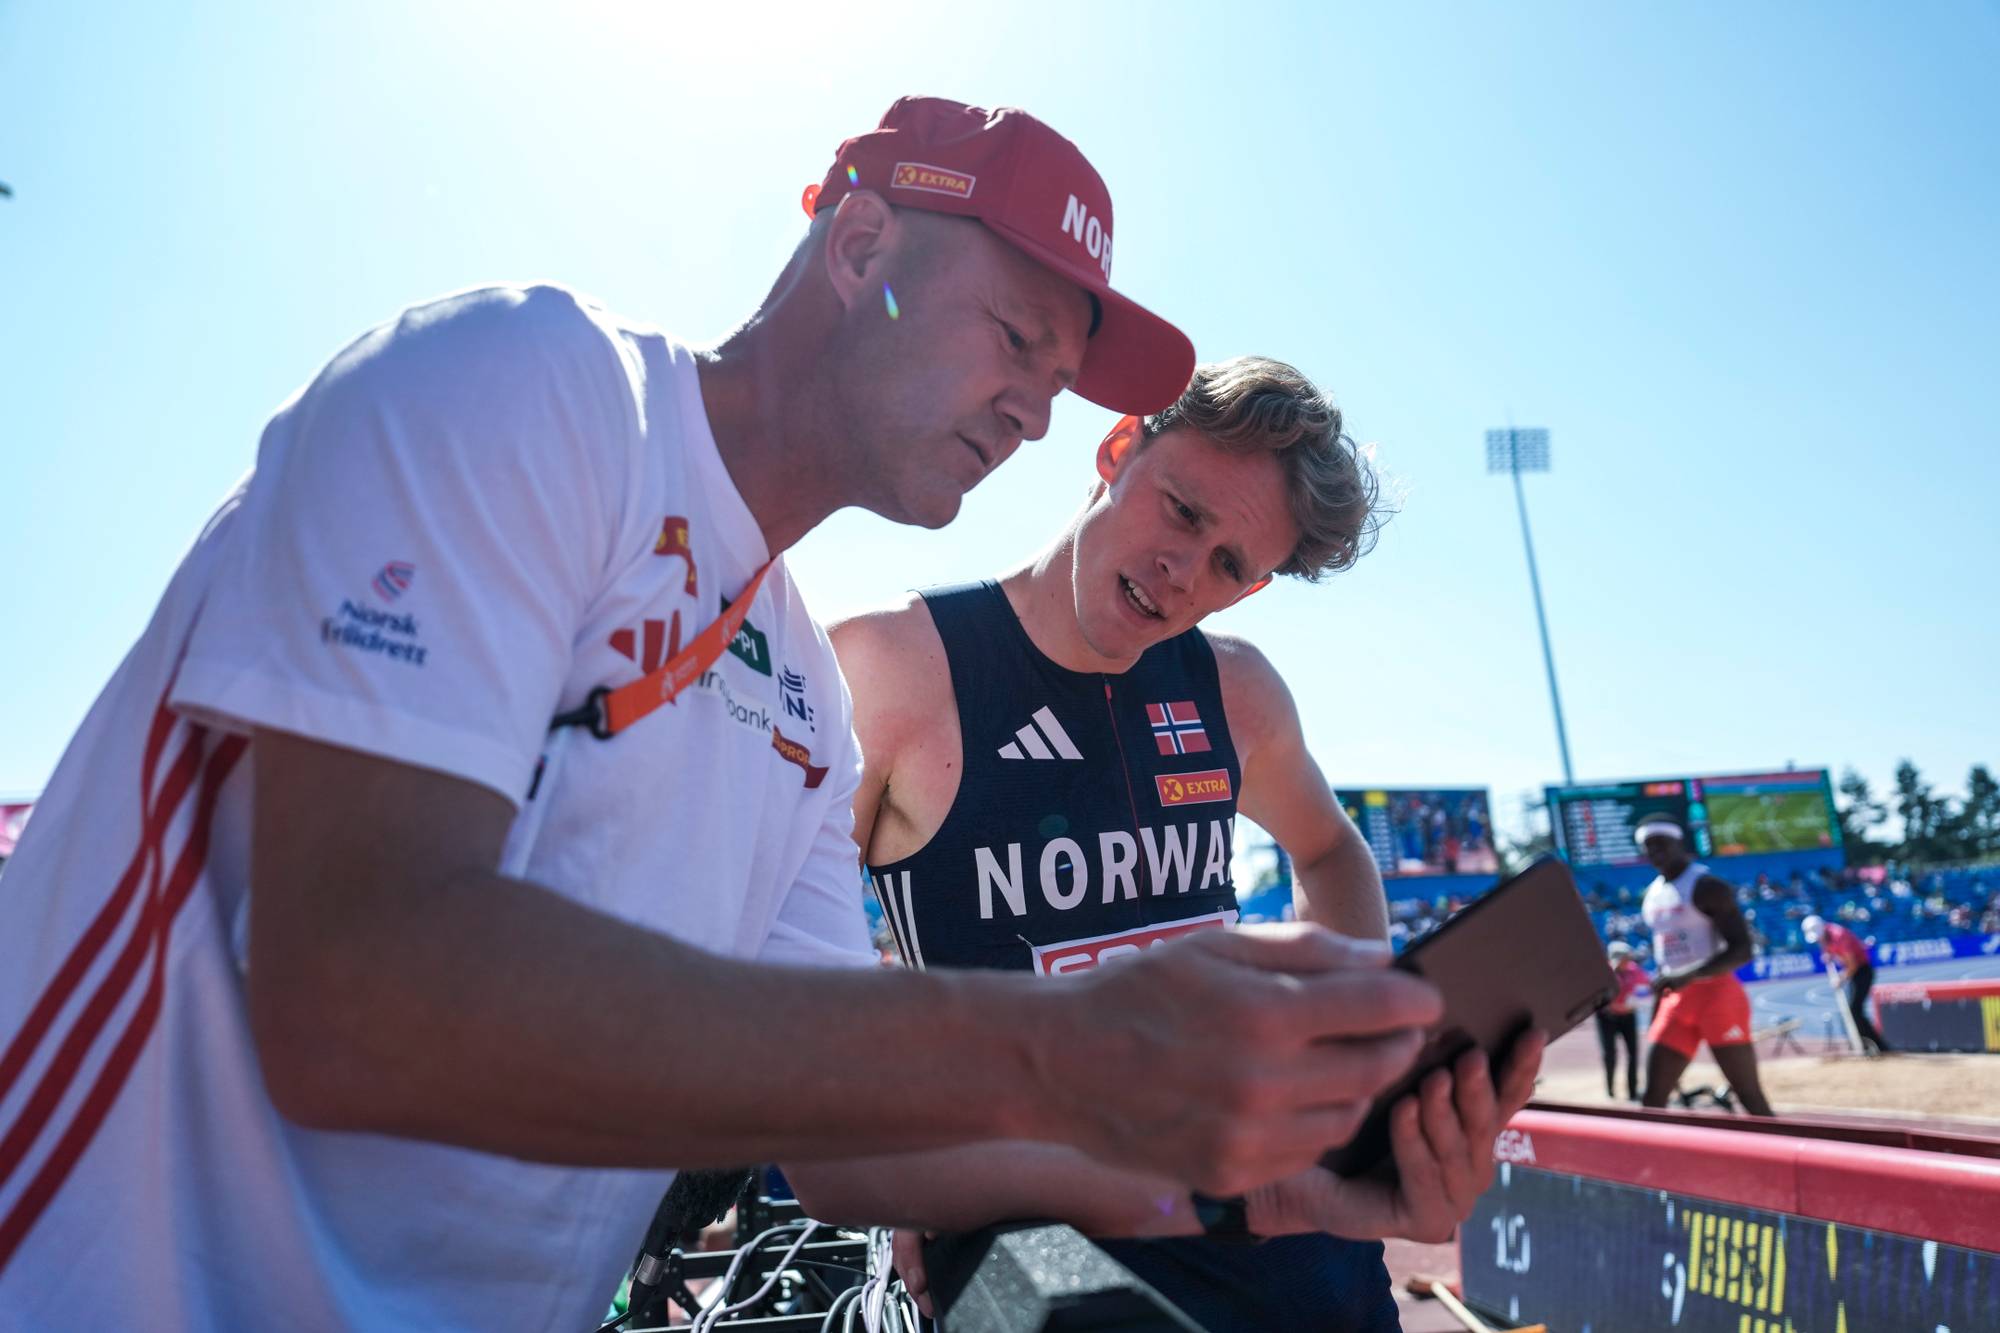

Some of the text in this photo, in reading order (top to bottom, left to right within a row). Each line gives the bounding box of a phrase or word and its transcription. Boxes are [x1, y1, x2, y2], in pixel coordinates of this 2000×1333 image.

[919, 171, 966, 191] EXTRA
[1186, 779, 1228, 795] EXTRA
[1493, 1129, 1536, 1165] EGA
